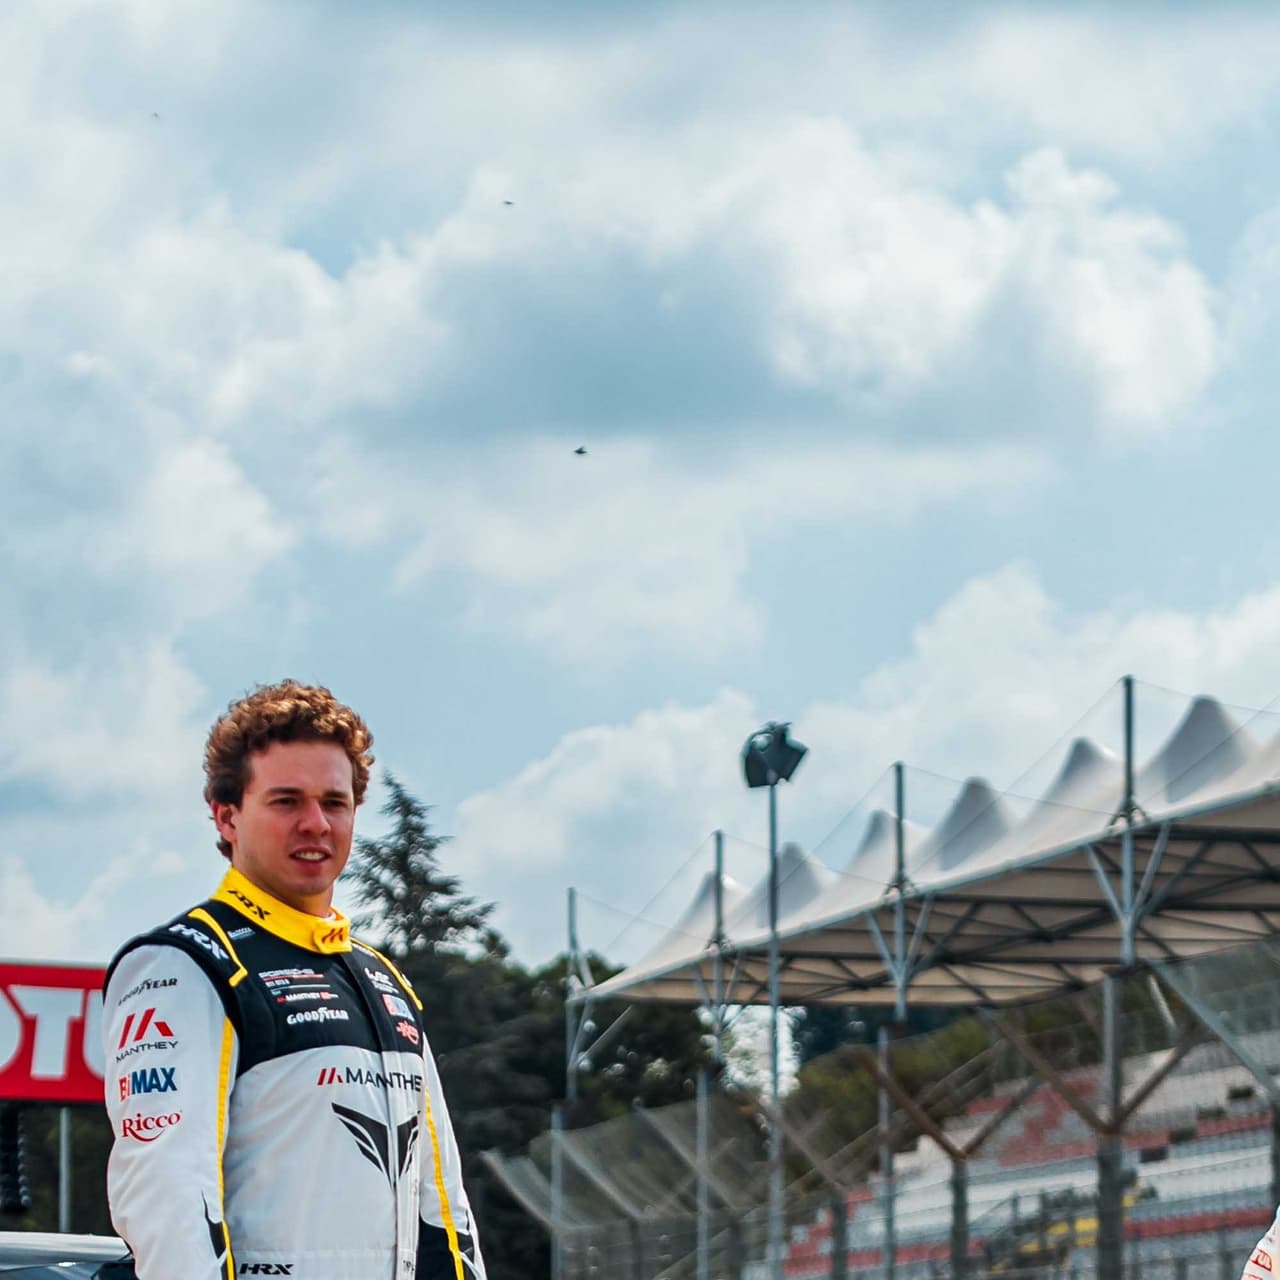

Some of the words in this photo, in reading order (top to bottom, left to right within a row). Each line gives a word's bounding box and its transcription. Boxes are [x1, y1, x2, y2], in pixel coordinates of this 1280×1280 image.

[168, 924, 230, 960] HRX
[286, 1006, 350, 1026] GOODYEAR
[115, 1040, 179, 1064] MANTHEY
[118, 1066, 177, 1101] BiMAX
[239, 1262, 294, 1276] HRX
